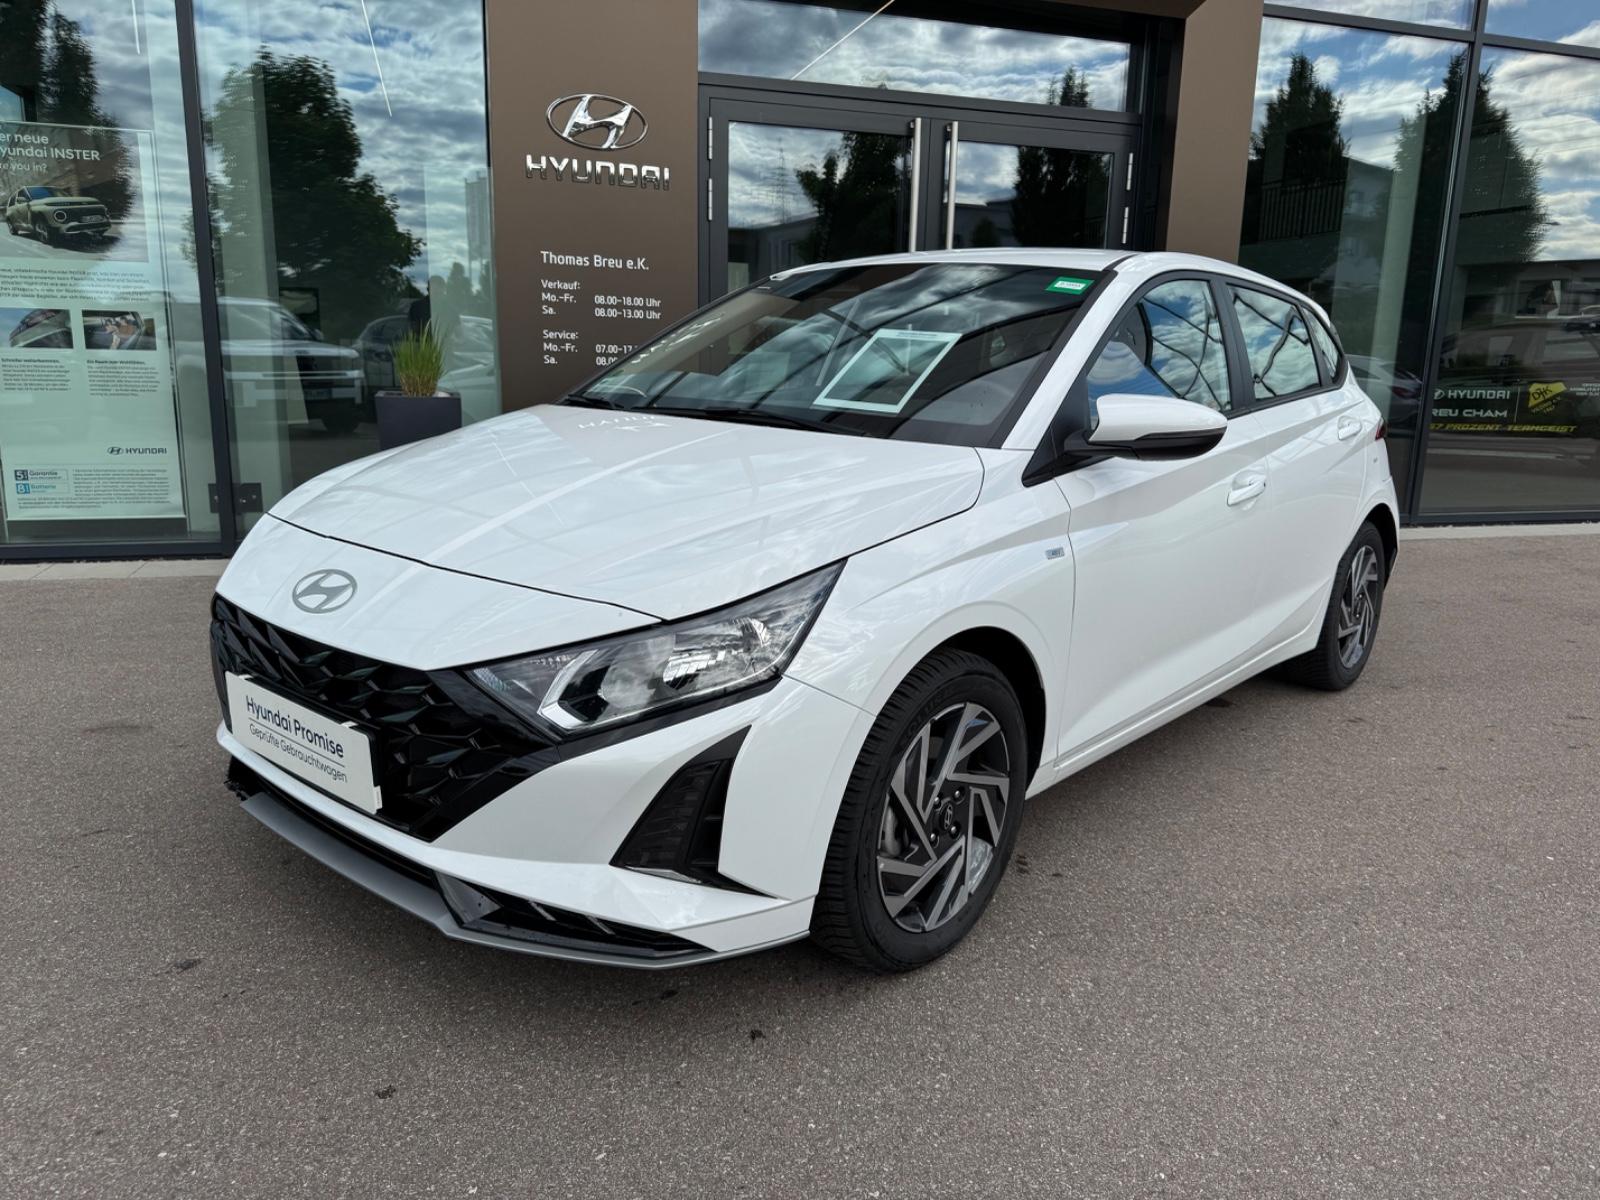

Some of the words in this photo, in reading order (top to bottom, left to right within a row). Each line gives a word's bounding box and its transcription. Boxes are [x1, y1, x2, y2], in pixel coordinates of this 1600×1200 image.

[0, 132, 12, 143] er
[14, 133, 49, 144] neue
[0, 146, 48, 158] yundai
[50, 147, 100, 161] INSTER
[526, 154, 670, 191] HYUNDAI
[540, 250, 590, 267] Thomas
[593, 254, 623, 269] Breu
[626, 257, 650, 270] e.K.
[541, 279, 581, 290] Verkauf:
[541, 292, 577, 303] Mo.-Fr.
[594, 295, 644, 307] 08.00-18.00
[645, 297, 662, 307] Uhr
[542, 305, 556, 315] Sa.
[594, 307, 644, 319] 08.00-13.00
[645, 309, 662, 320] Uhr
[542, 329, 579, 340] Service:
[543, 342, 578, 353] Mo.-Fr.
[543, 354, 558, 365] Sa.
[1447, 389, 1511, 400] HYUNDAI
[1431, 408, 1459, 417] REU
[1462, 409, 1508, 418] CHAM
[1445, 423, 1501, 432] PROZENT
[125, 447, 167, 455] HYUNDAI
[246, 695, 292, 734] Hyundai
[294, 718, 344, 759] Promise
[250, 723, 280, 748] Geprüfte
[280, 739, 347, 783] Gebrauchtwagen
